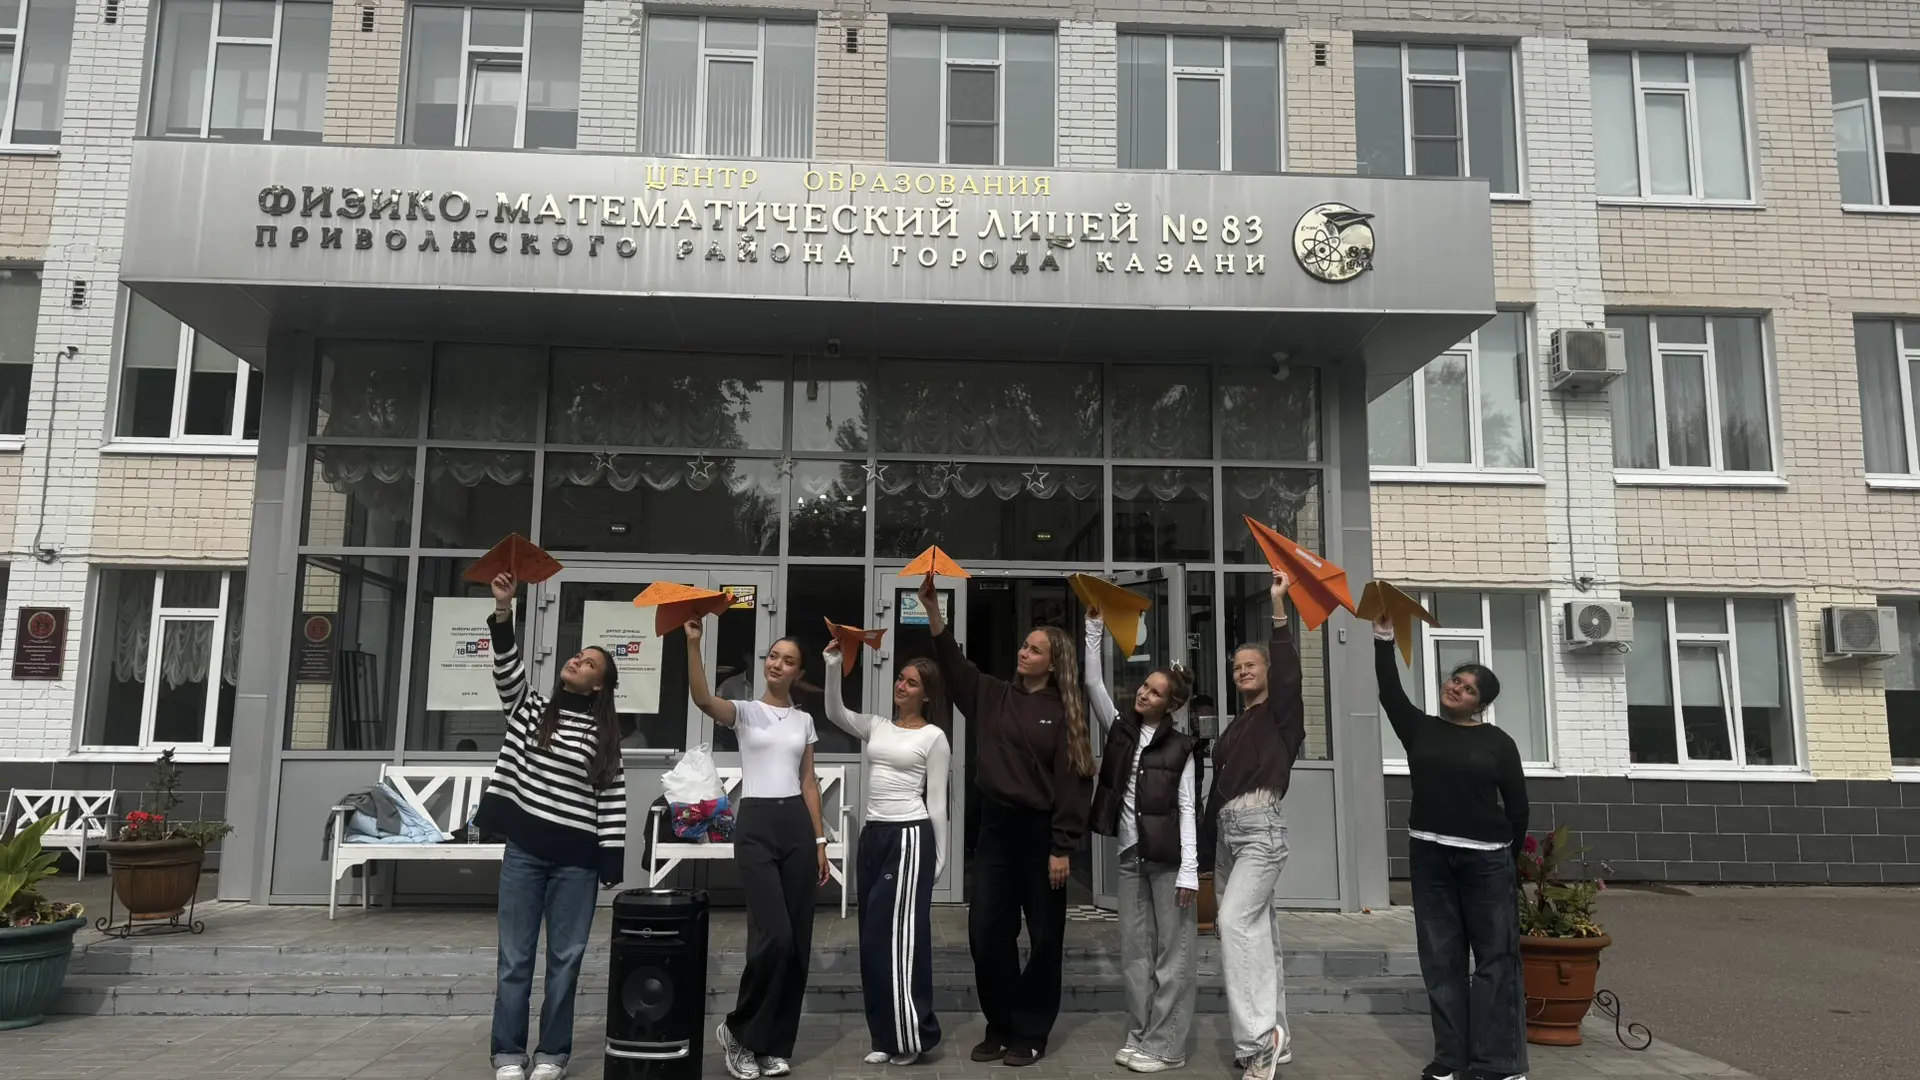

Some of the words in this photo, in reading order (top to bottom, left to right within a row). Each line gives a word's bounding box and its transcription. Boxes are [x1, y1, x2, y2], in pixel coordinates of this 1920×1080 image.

[644, 164, 759, 190] ЦЕНТР
[803, 170, 1051, 196] ОБРАЗОВАНИЯ
[258, 185, 959, 238] ФИЗИКО-МАТЕМАТИЧЕСКИЙ
[977, 202, 1138, 249] ЛИЦЕЙ
[1221, 215, 1264, 245] 83
[256, 225, 637, 259] ПРИВОЛЖСКОГО
[677, 234, 855, 265] РАЙОНА
[892, 246, 1060, 274] ГОРОДА
[1096, 251, 1266, 275] КАЗАНИ
[1347, 246, 1371, 260] 83
[467, 644, 476, 652] 19
[478, 641, 488, 649] 20
[628, 644, 638, 652] 20
